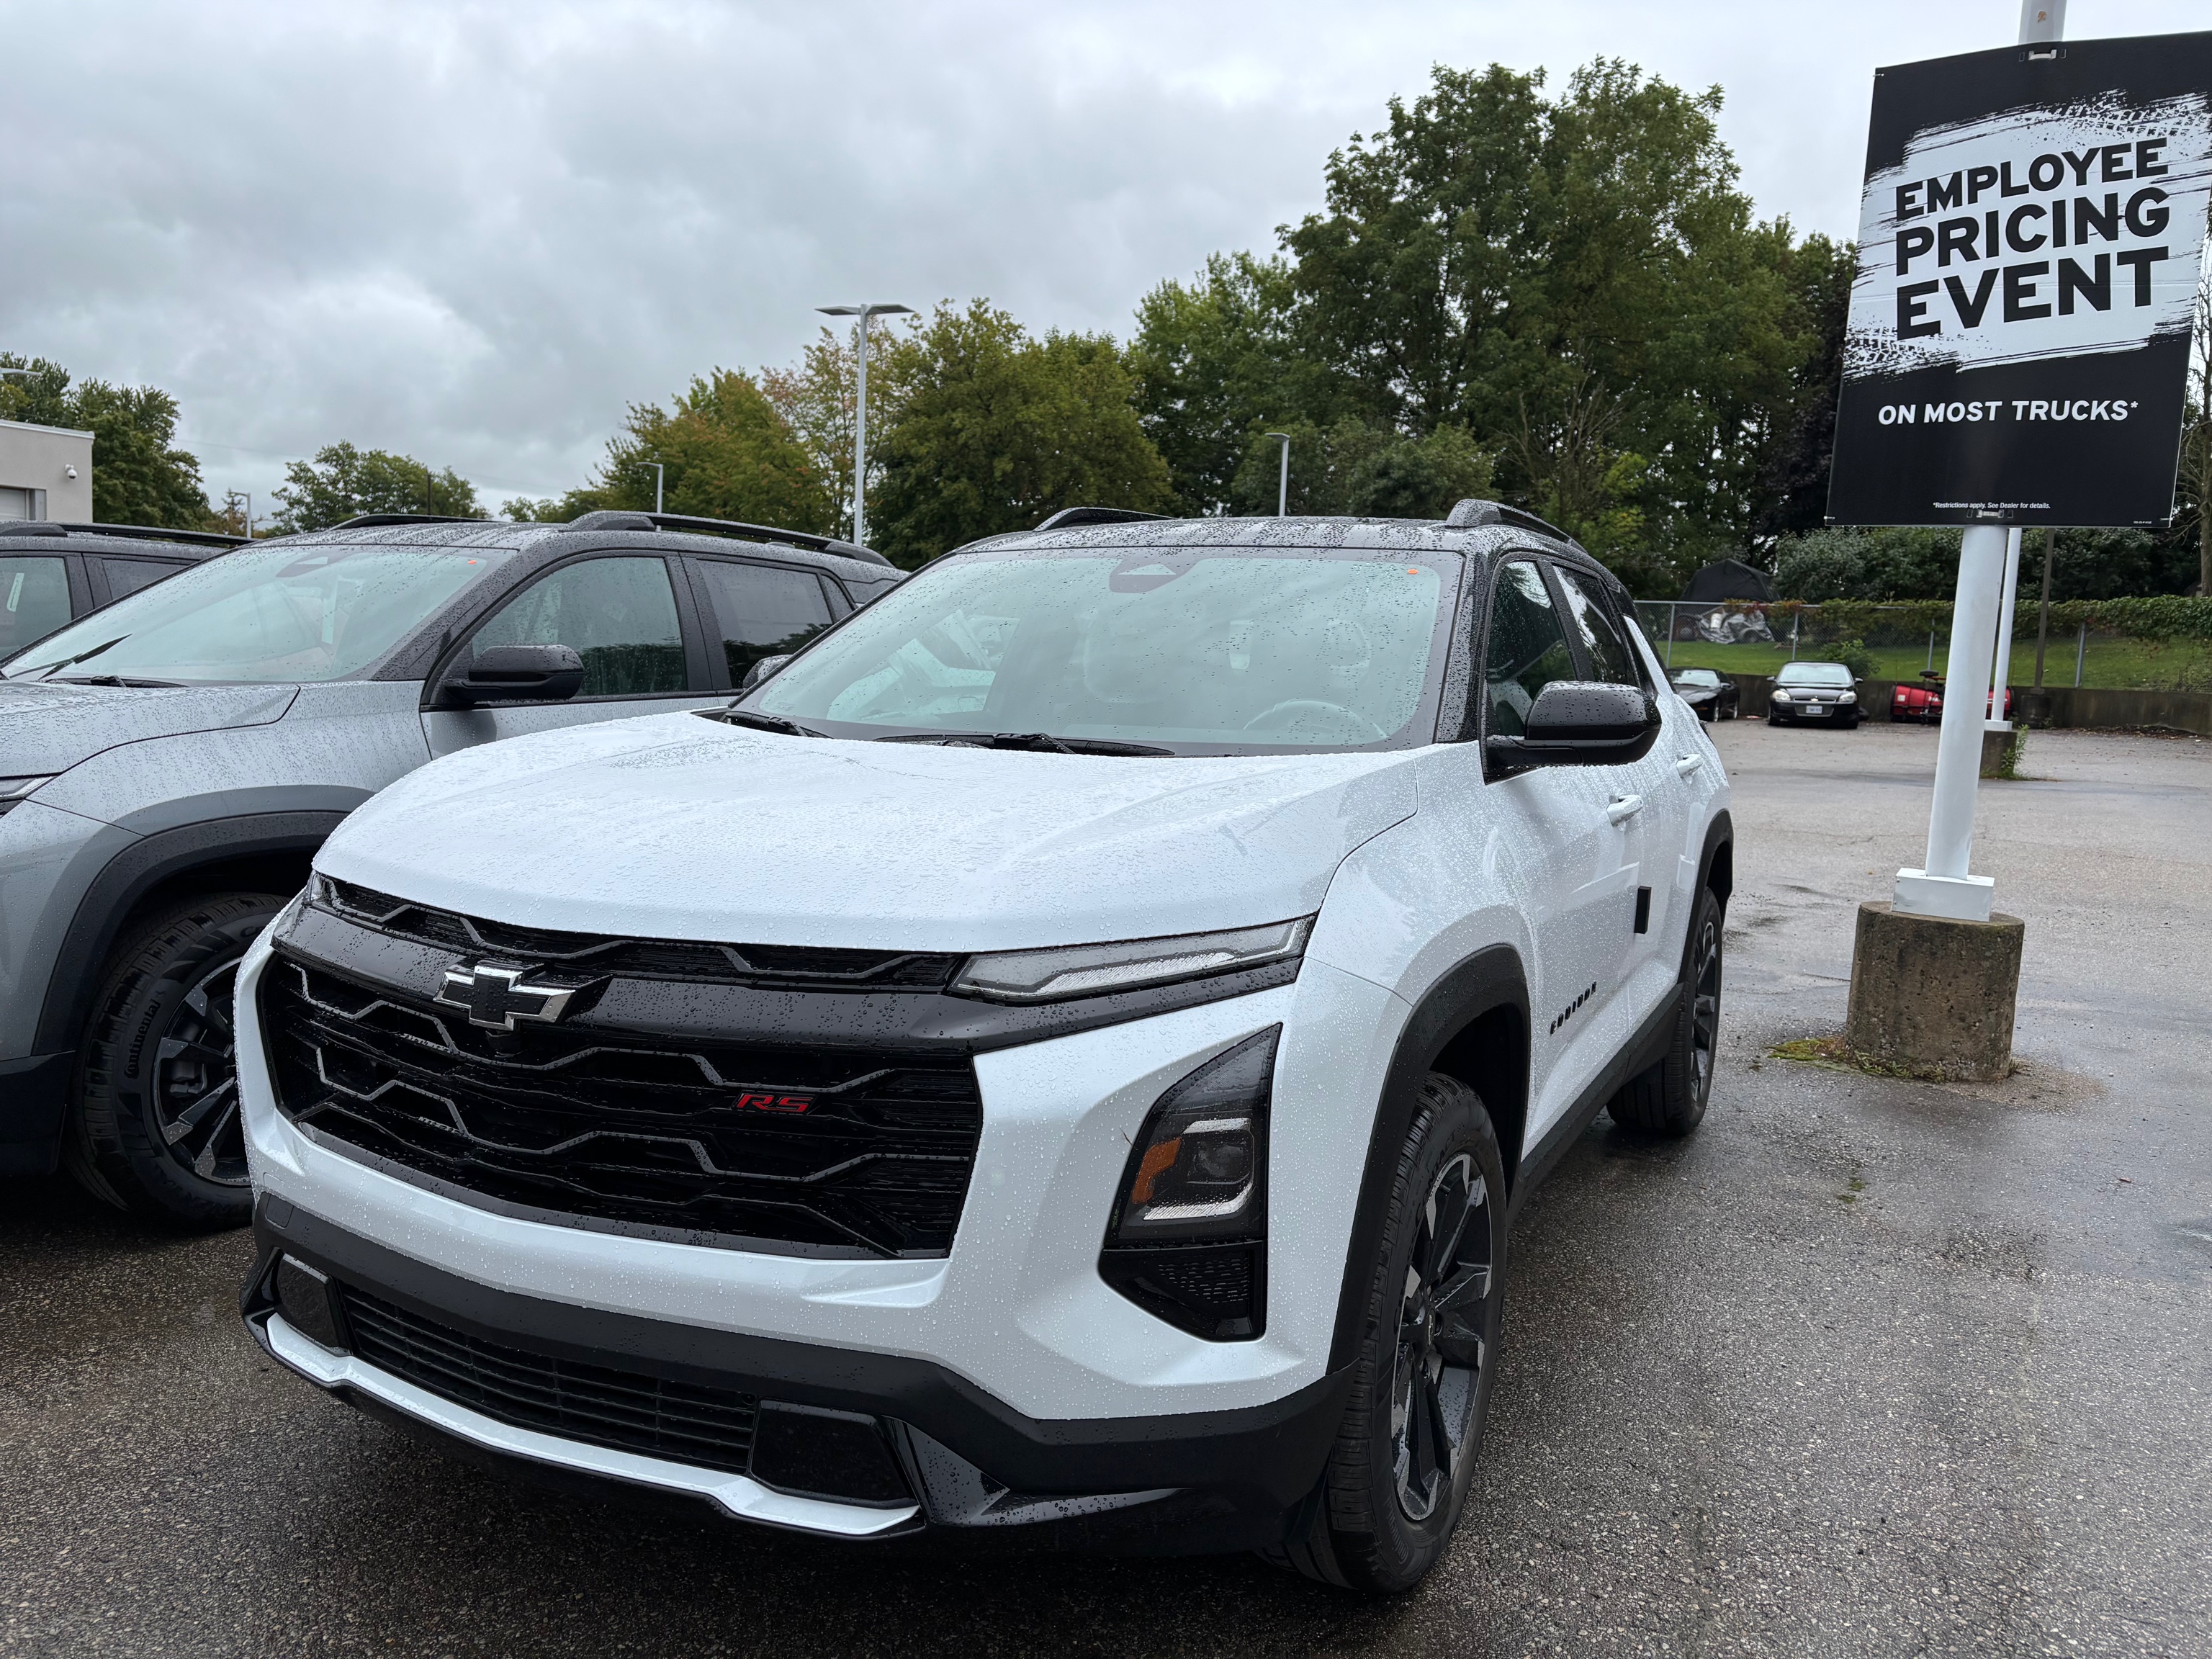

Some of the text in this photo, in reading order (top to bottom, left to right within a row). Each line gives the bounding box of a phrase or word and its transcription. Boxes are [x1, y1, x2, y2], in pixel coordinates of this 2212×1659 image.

[1896, 138, 2168, 221] EMPLOYEE
[1896, 187, 2169, 276] PRICING
[1897, 246, 2169, 341] EVENT
[1878, 405, 1916, 425] ON
[1923, 400, 2002, 423] MOST
[124, 998, 161, 1079] Continental
[736, 1092, 814, 1112] RS
